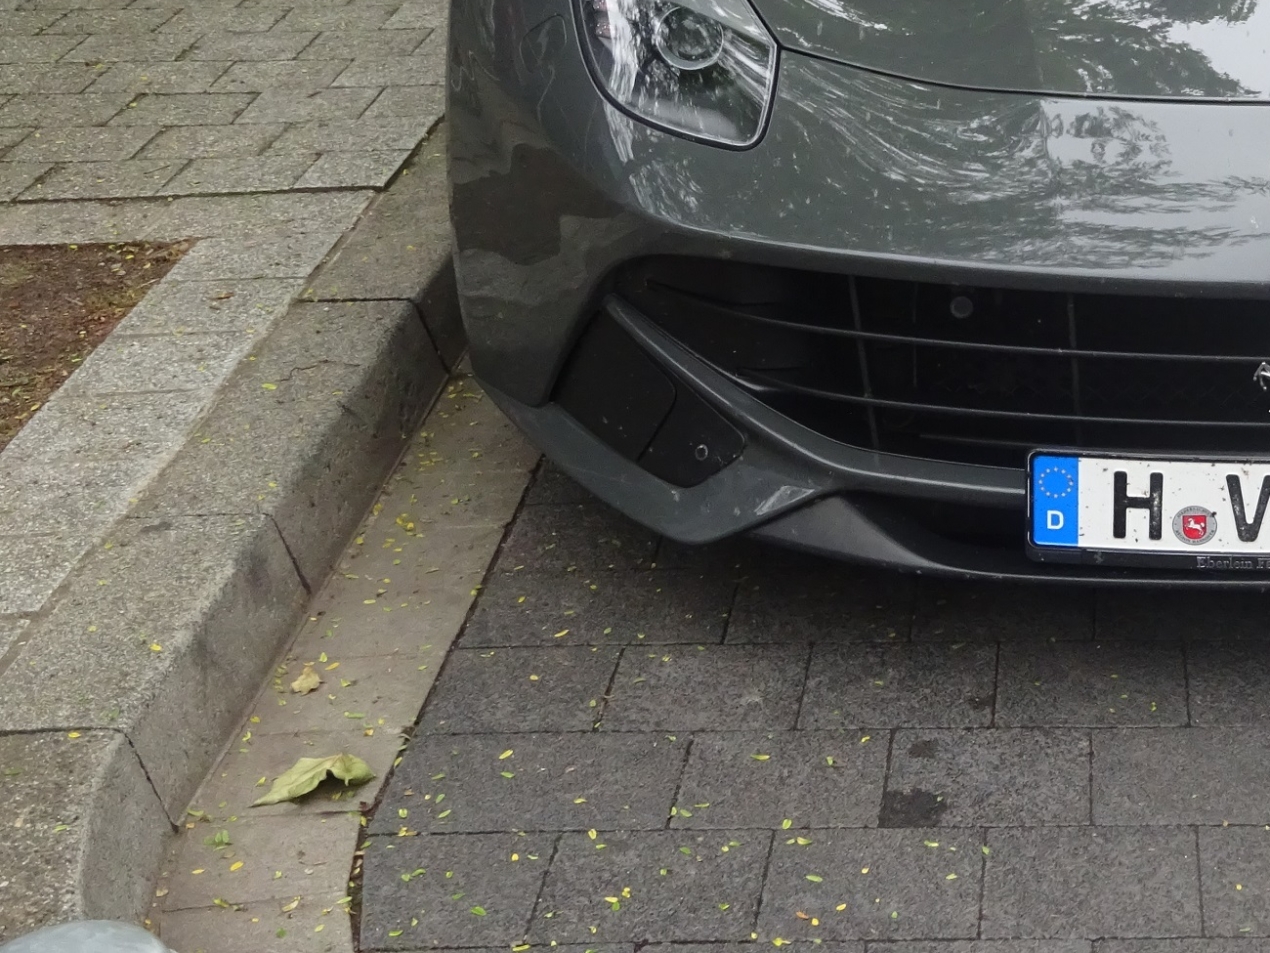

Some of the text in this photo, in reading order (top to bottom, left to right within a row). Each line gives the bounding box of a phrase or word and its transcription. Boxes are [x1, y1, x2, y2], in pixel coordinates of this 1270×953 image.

[1113, 471, 1163, 540] H
[1046, 510, 1064, 530] D
[1196, 556, 1253, 569] Eberlein
